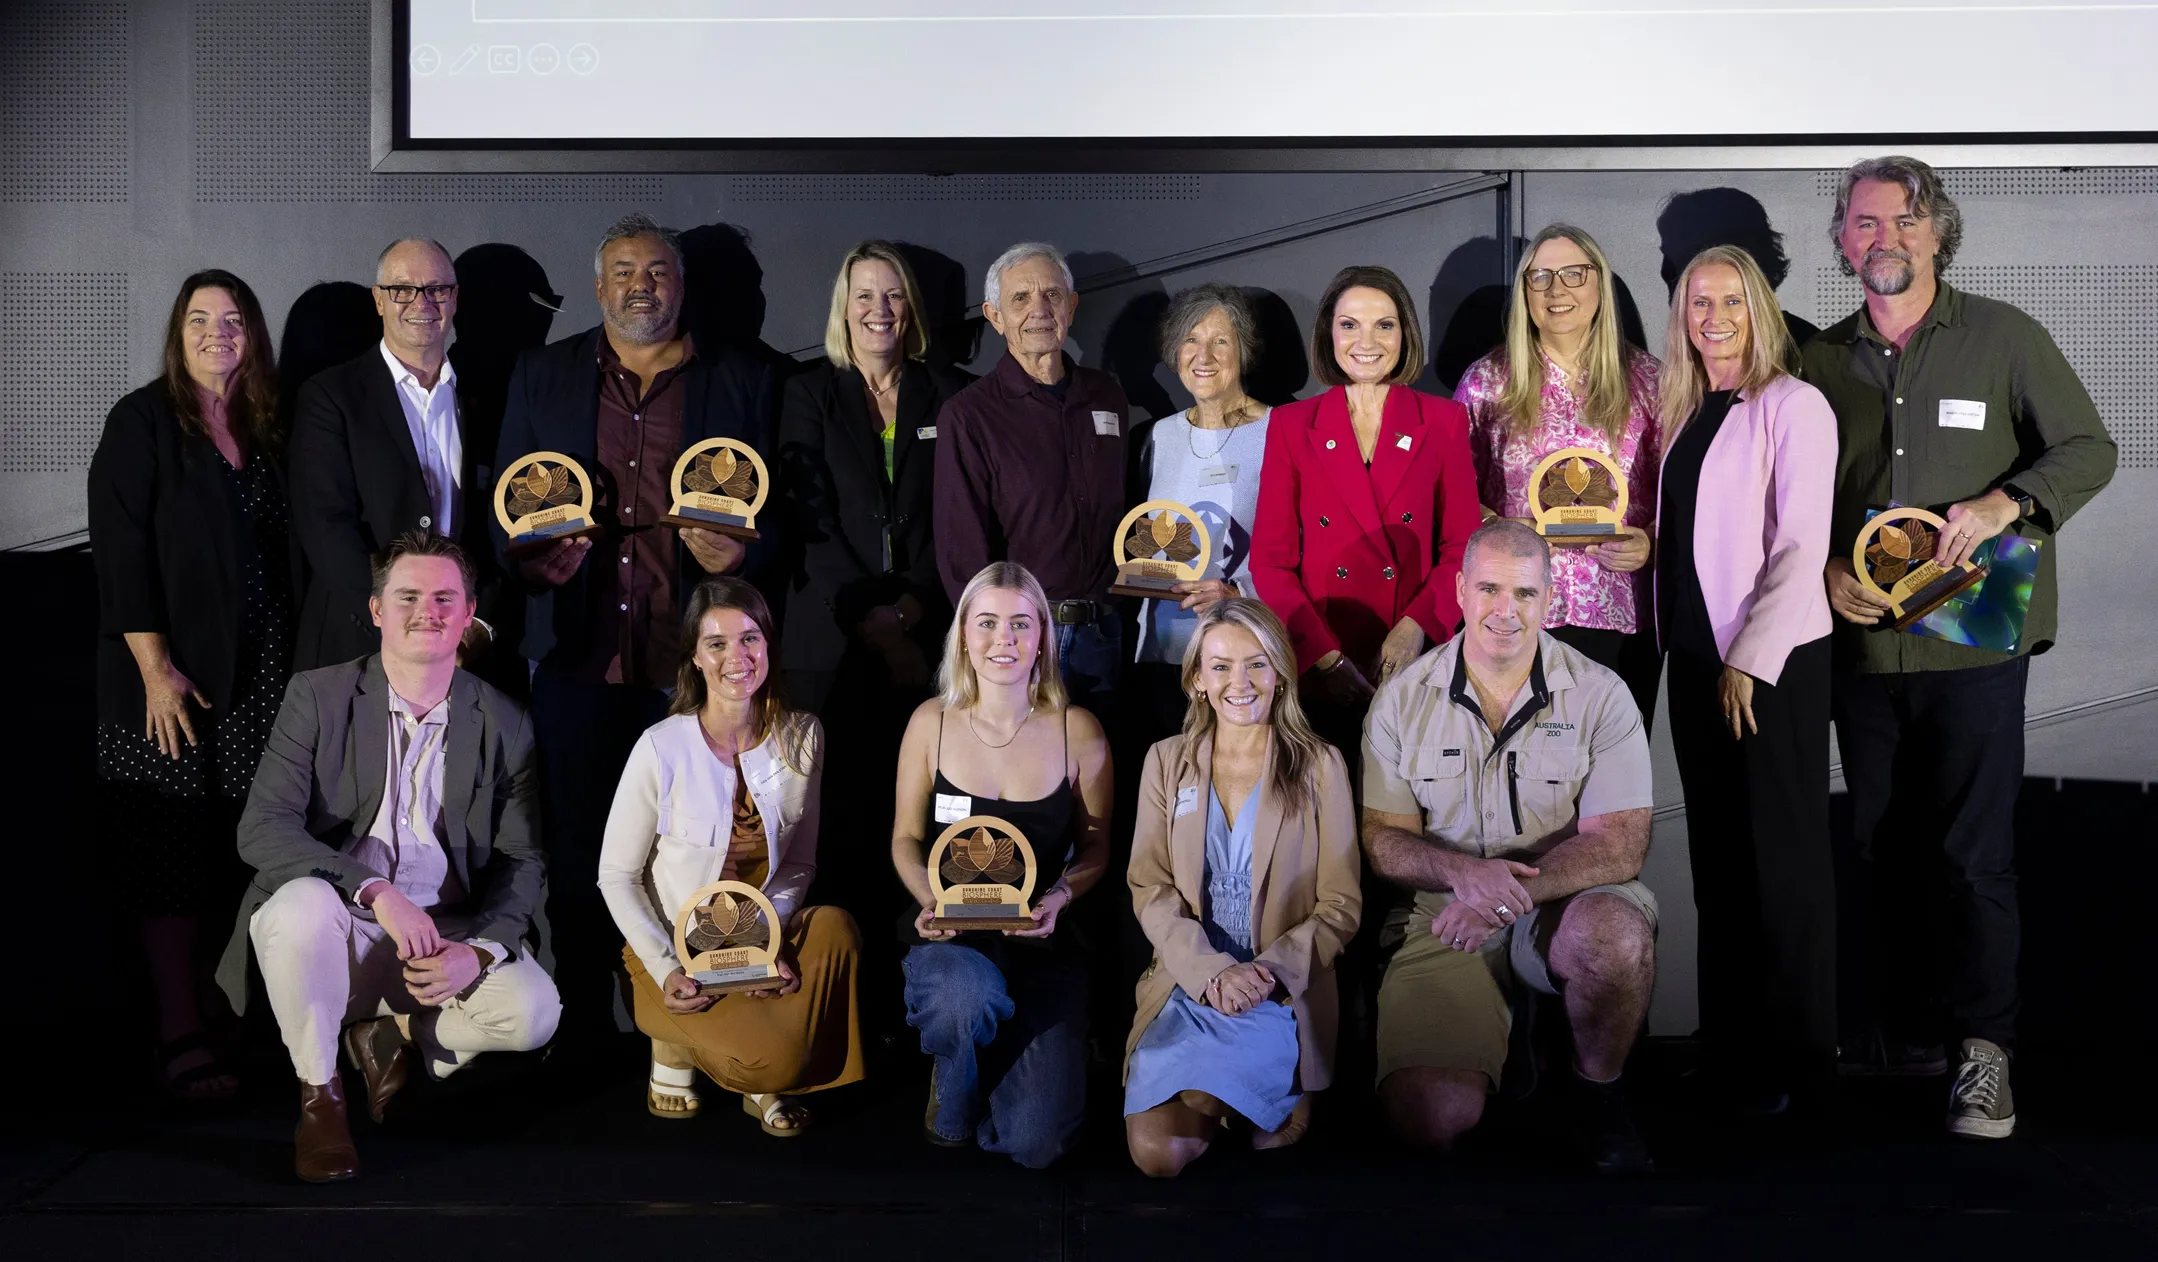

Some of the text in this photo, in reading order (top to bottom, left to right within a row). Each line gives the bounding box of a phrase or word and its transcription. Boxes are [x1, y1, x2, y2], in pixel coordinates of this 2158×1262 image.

[493, 53, 514, 66] CC
[1534, 722, 1575, 730] AUSTRALIA
[710, 955, 749, 965] BIOSPHERE
